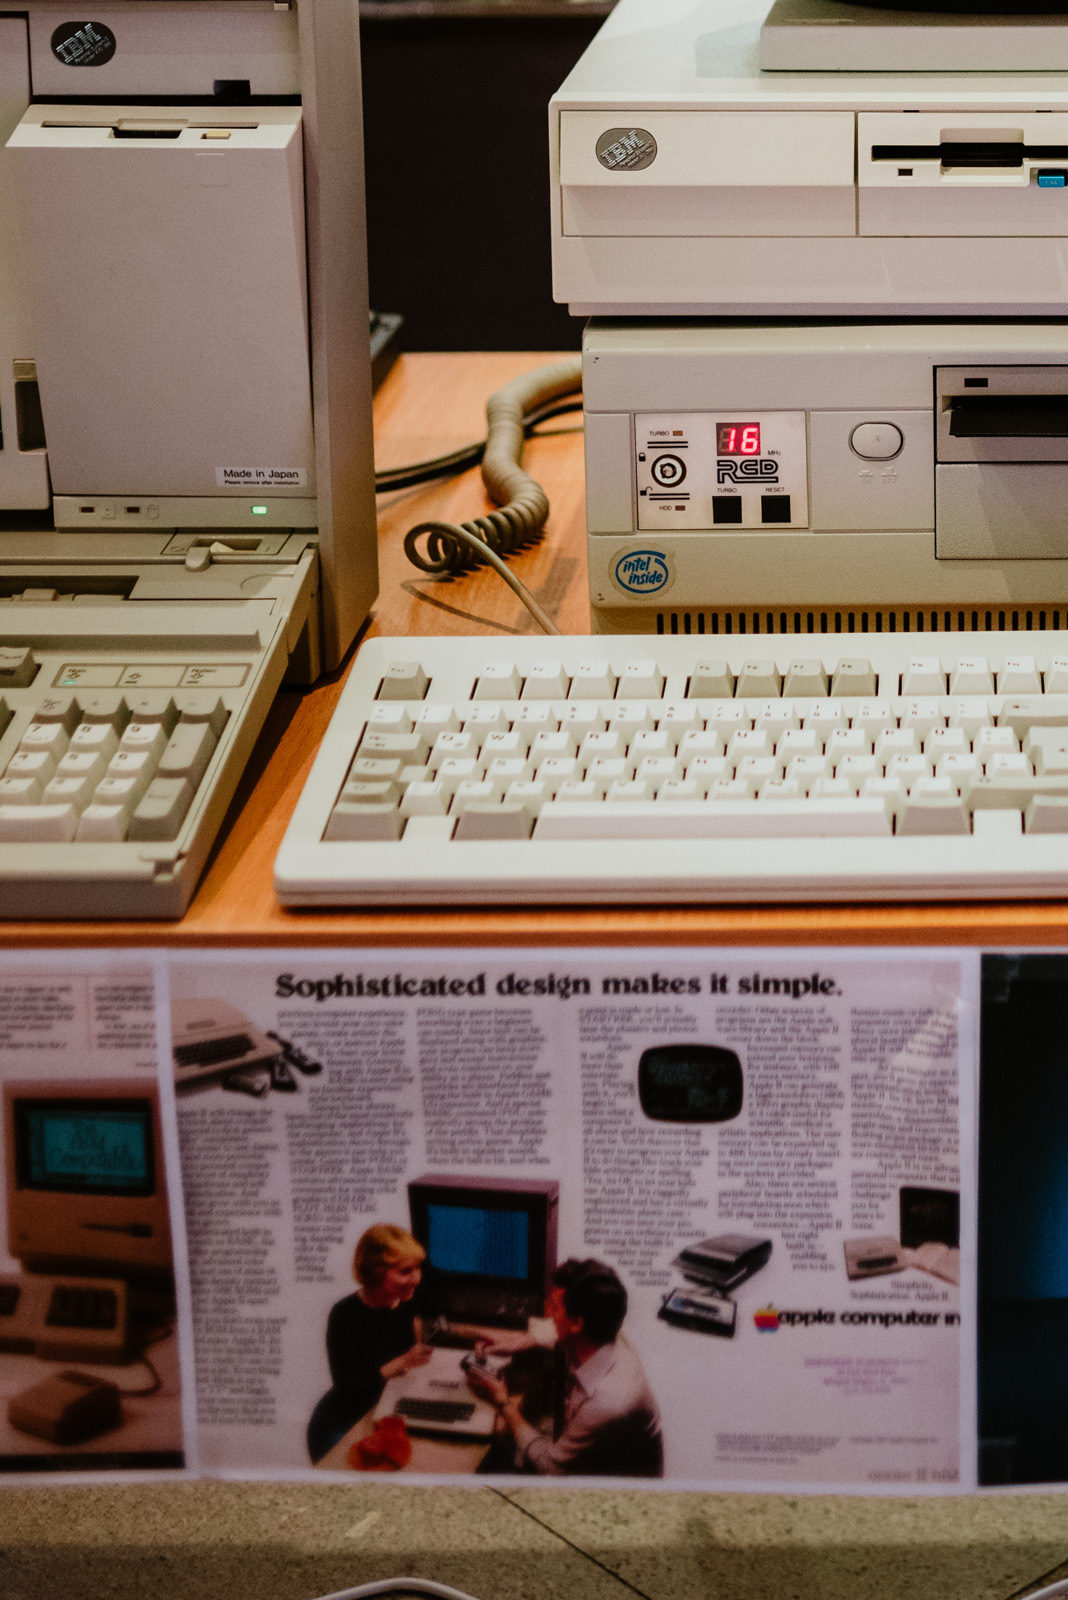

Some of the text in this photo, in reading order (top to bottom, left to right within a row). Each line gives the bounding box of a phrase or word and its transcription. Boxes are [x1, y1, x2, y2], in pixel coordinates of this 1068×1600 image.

[56, 23, 101, 63] IBM
[600, 130, 644, 167] IBM
[728, 428, 758, 453] 16
[268, 470, 299, 479] Japan
[623, 556, 651, 573] intel
[628, 570, 663, 585] inside
[275, 973, 843, 1003] Sophisticated design makes it simple.
[778, 1308, 836, 1327] apple
[840, 1308, 940, 1329] computer
